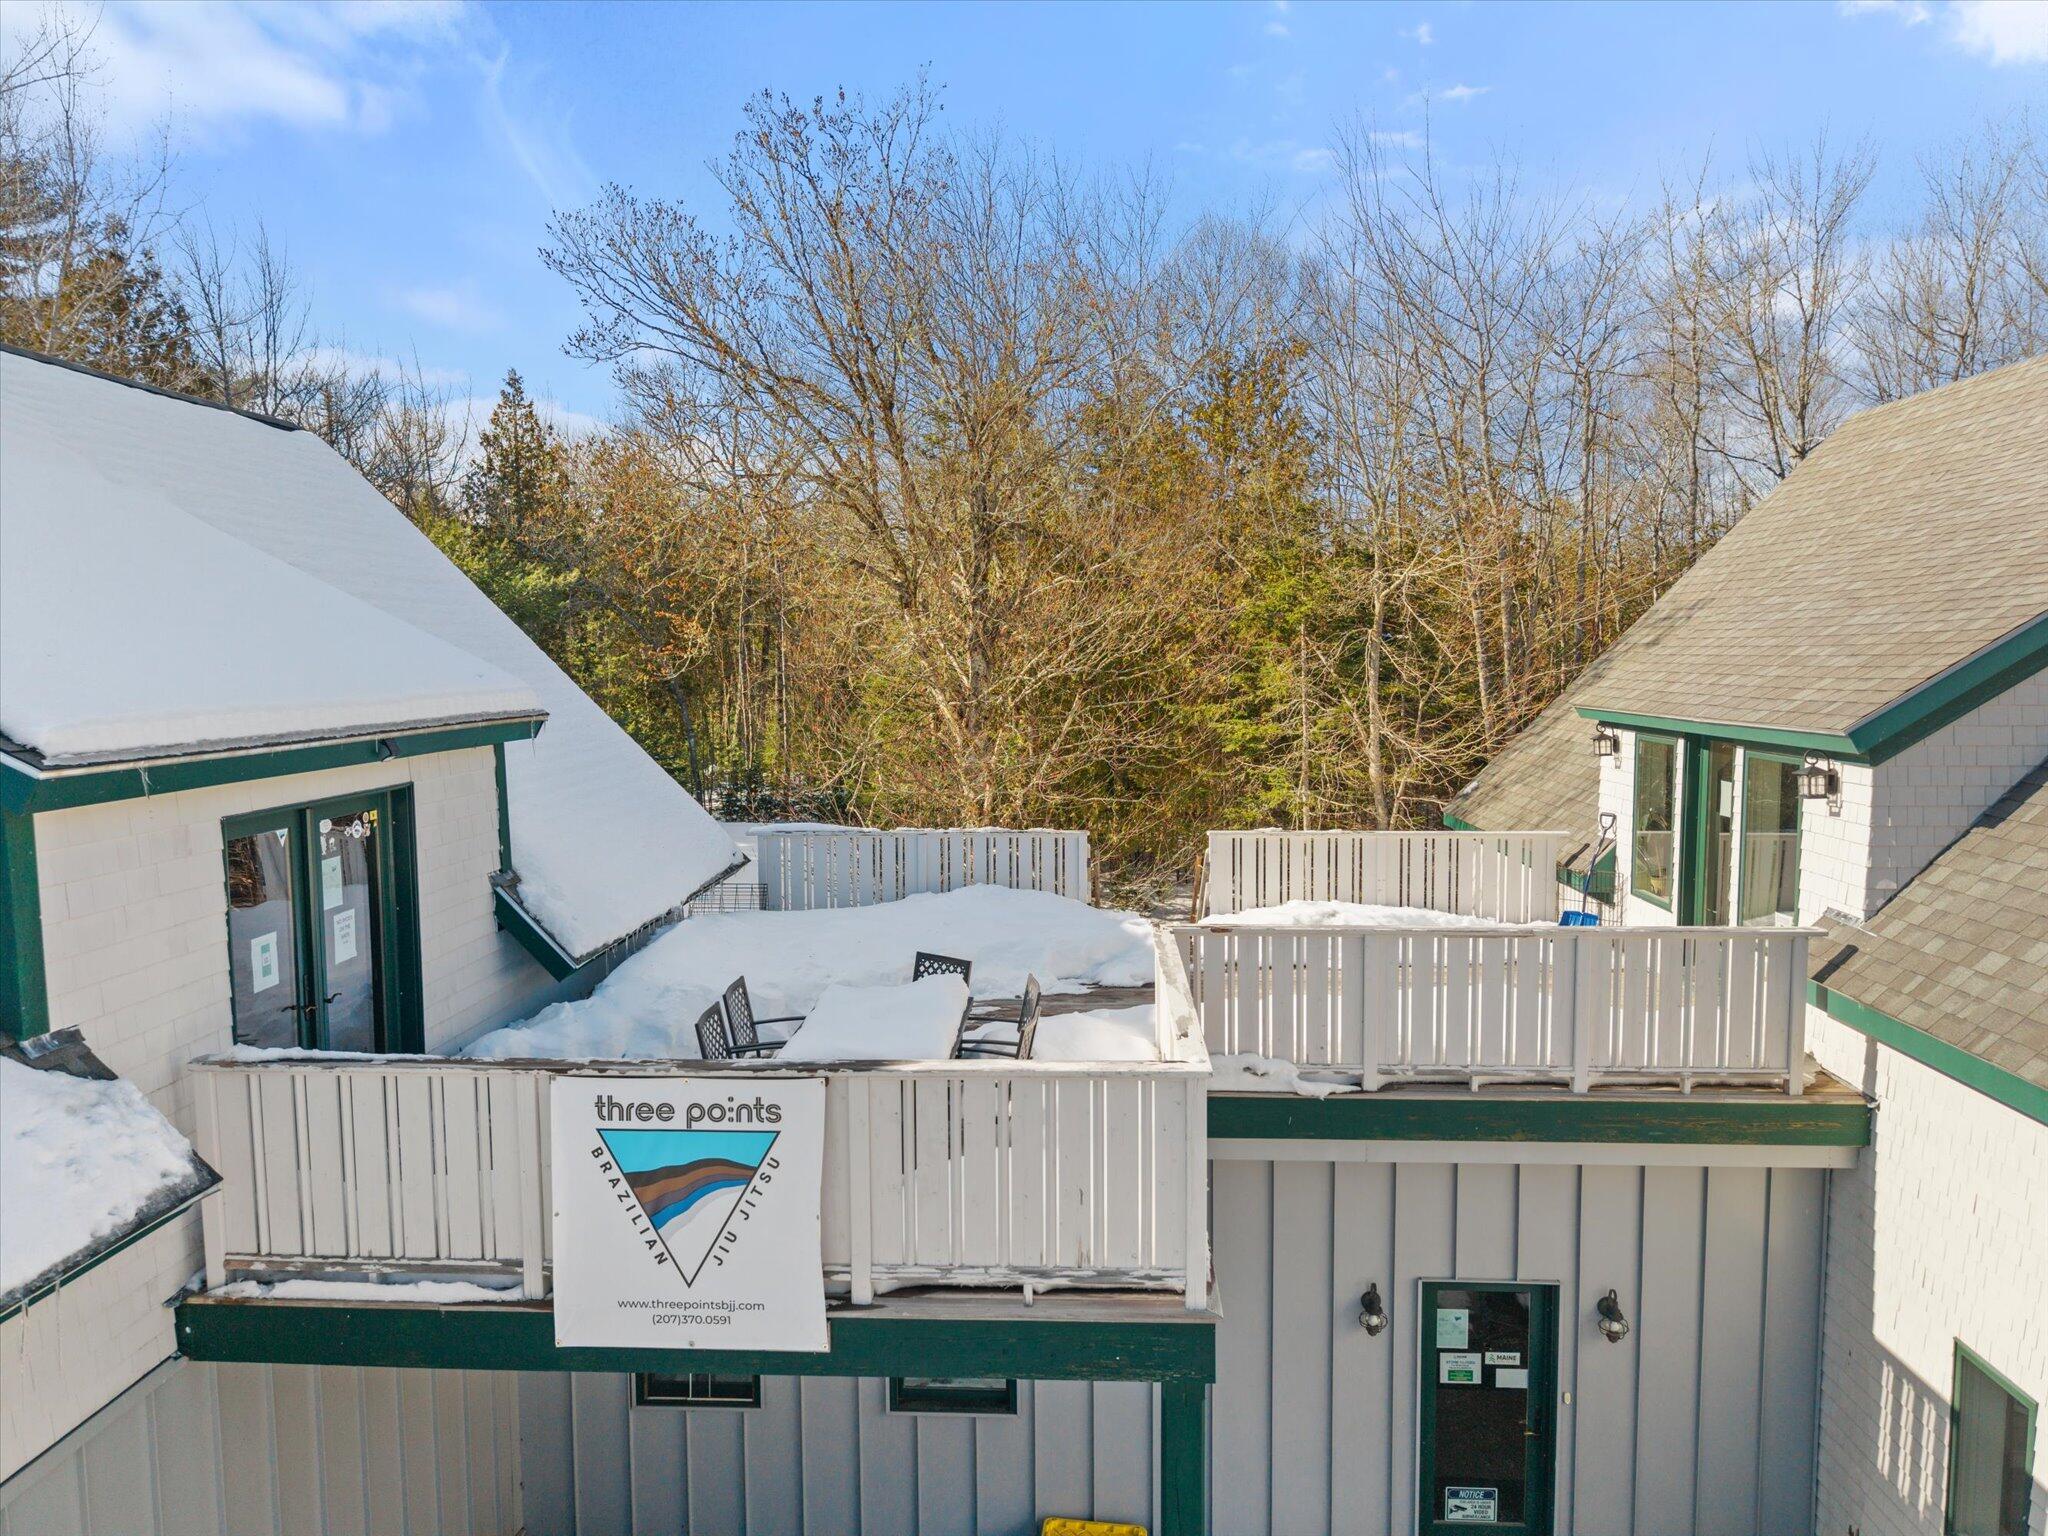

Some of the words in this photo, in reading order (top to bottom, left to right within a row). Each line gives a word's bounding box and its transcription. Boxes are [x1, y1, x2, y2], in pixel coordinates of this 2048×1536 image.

[594, 1094, 675, 1122] three
[591, 1146, 669, 1265] BRAZILIAN
[713, 1231, 738, 1266] JIU
[739, 1157, 780, 1221] JITSU
[617, 1299, 765, 1313] www.threepointsbjj.com
[652, 1314, 732, 1326] (207)370.0591
[1458, 1490, 1484, 1498] NOTICE
